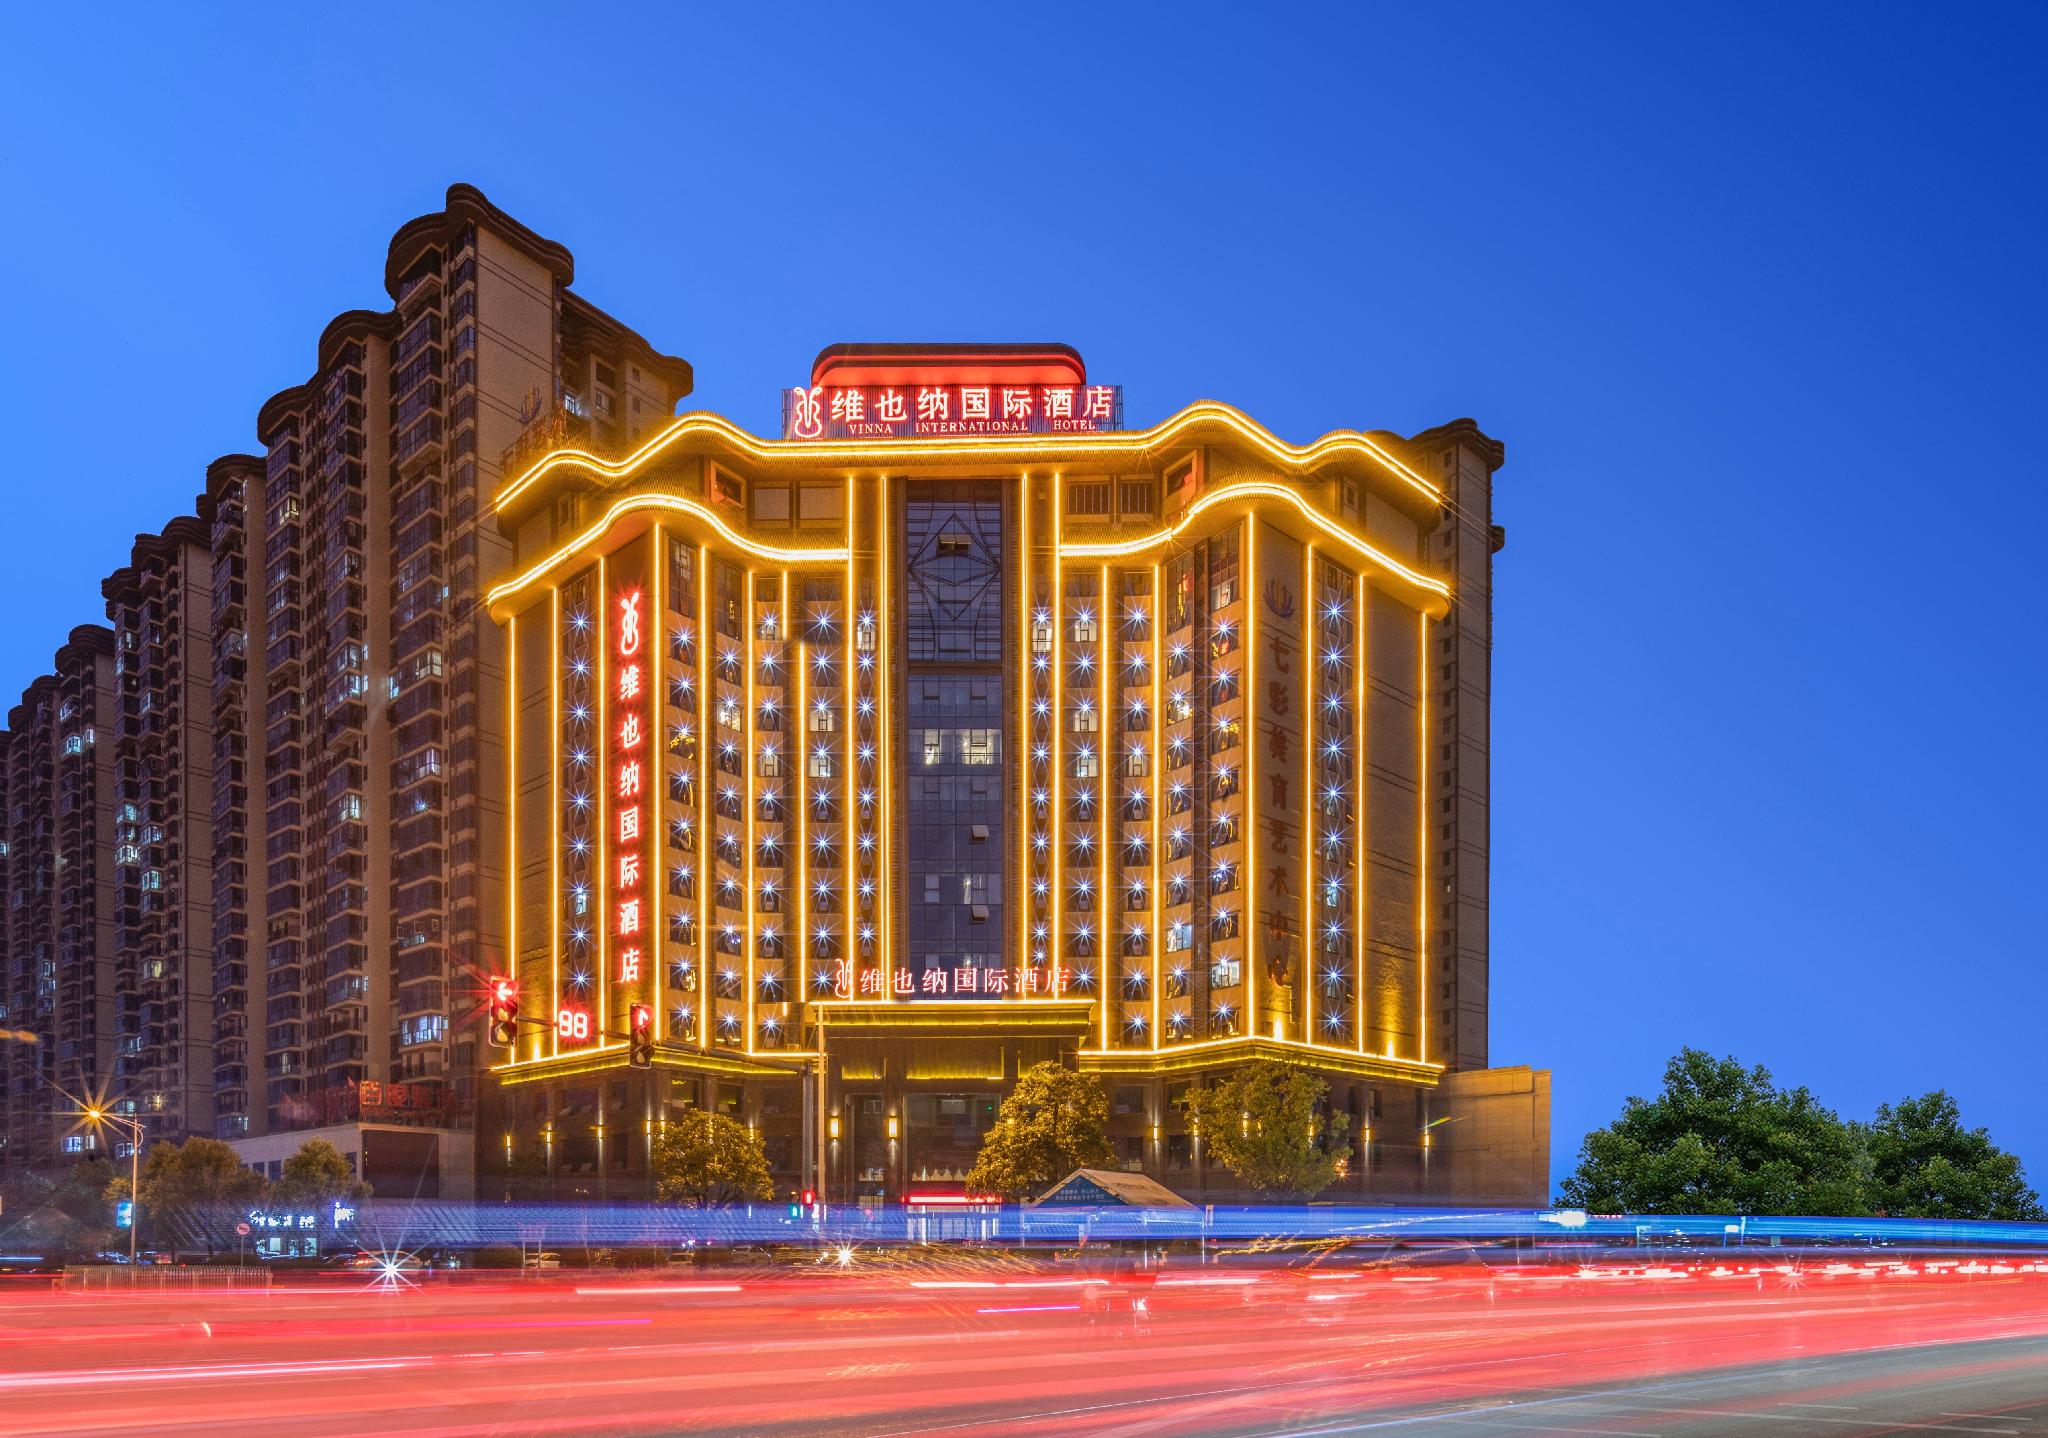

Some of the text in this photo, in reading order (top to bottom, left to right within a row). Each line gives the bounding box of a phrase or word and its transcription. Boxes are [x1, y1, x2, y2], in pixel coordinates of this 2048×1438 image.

[831, 385, 1114, 422] 维也纳国际酒店
[849, 419, 1096, 434] VINNA INTERNATIONAL HOTEL
[619, 664, 641, 984] 维也纳国际酒店
[859, 966, 1071, 994] 维也纳国际酒店
